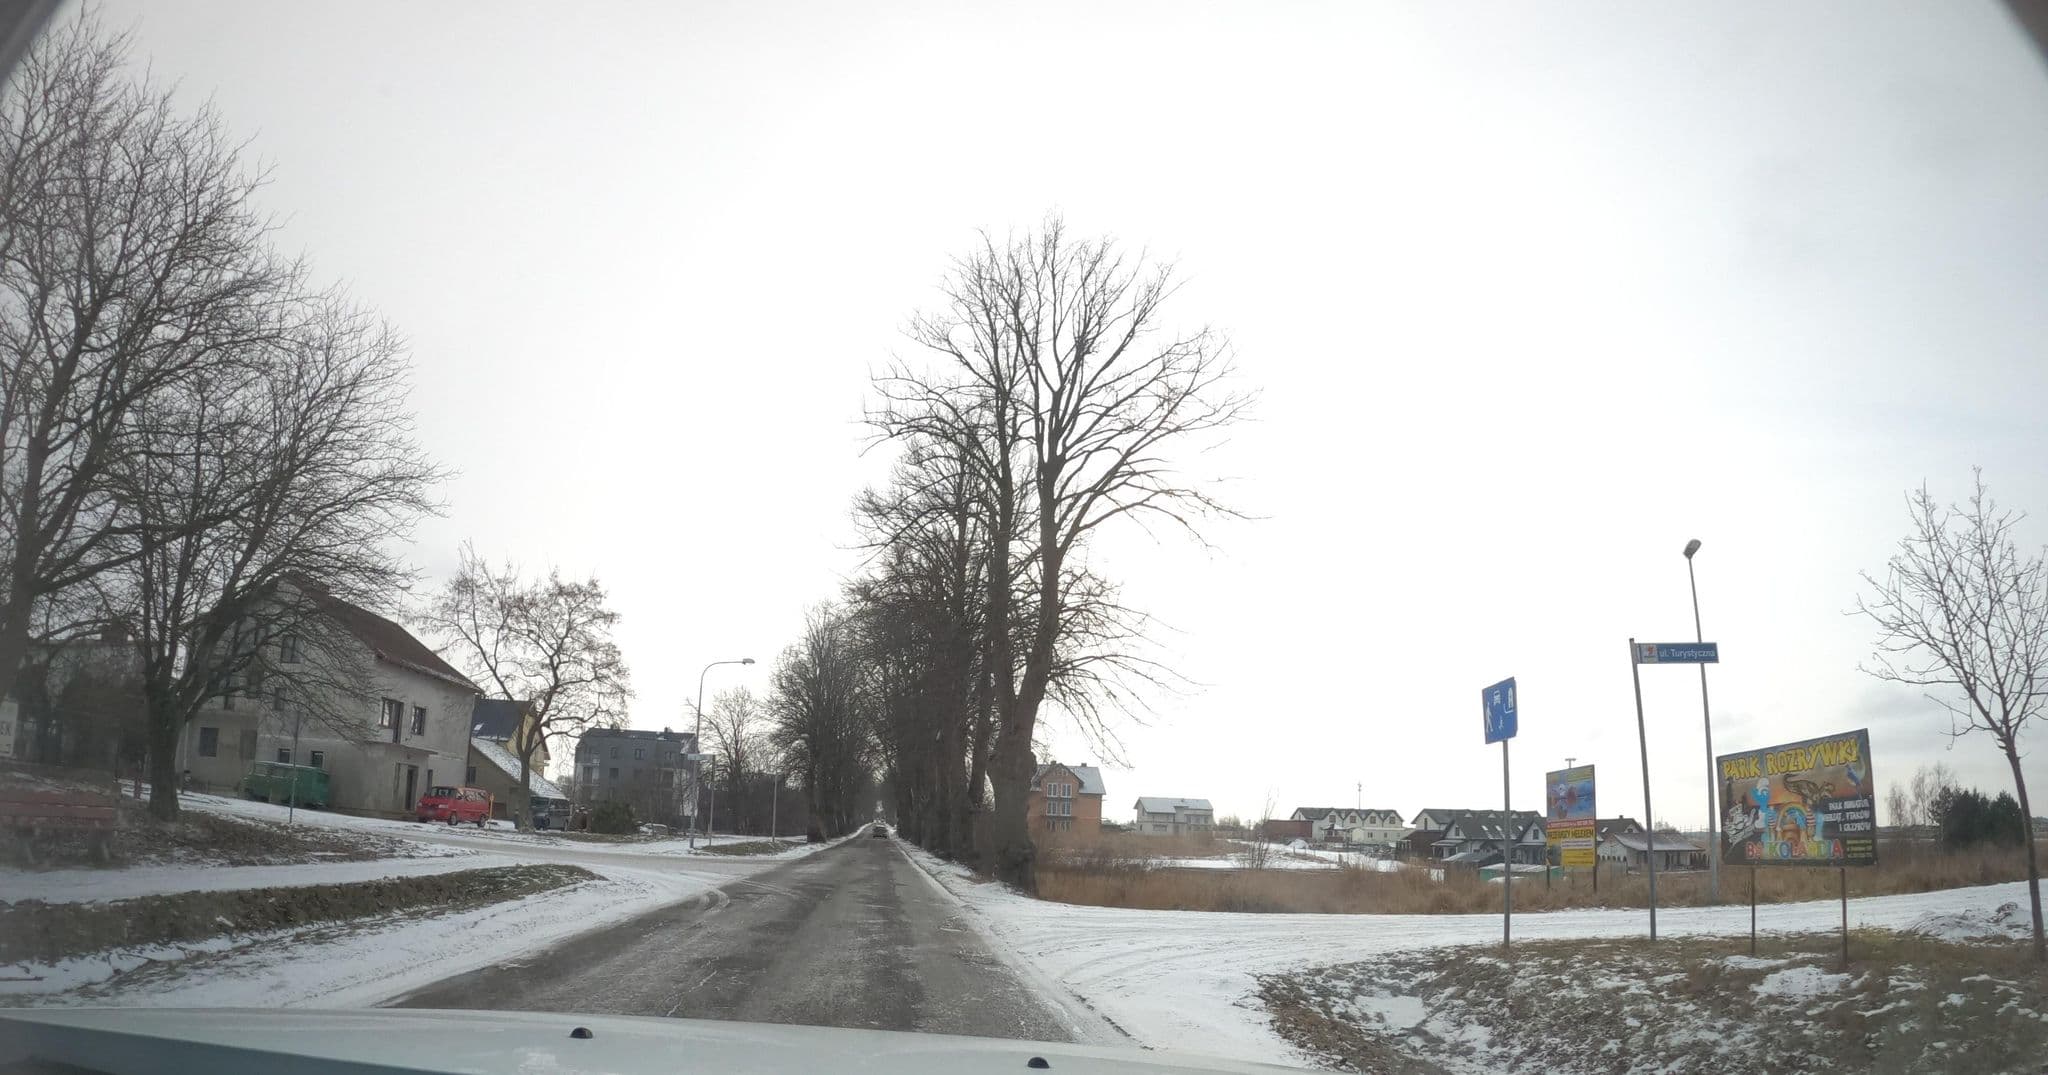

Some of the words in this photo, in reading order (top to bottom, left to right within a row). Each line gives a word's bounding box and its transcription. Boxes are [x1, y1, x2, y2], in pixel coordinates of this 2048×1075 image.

[1670, 647, 1716, 659] Turystyczna
[1722, 756, 1761, 779] PARK
[1766, 739, 1860, 775] ROZRYWKI
